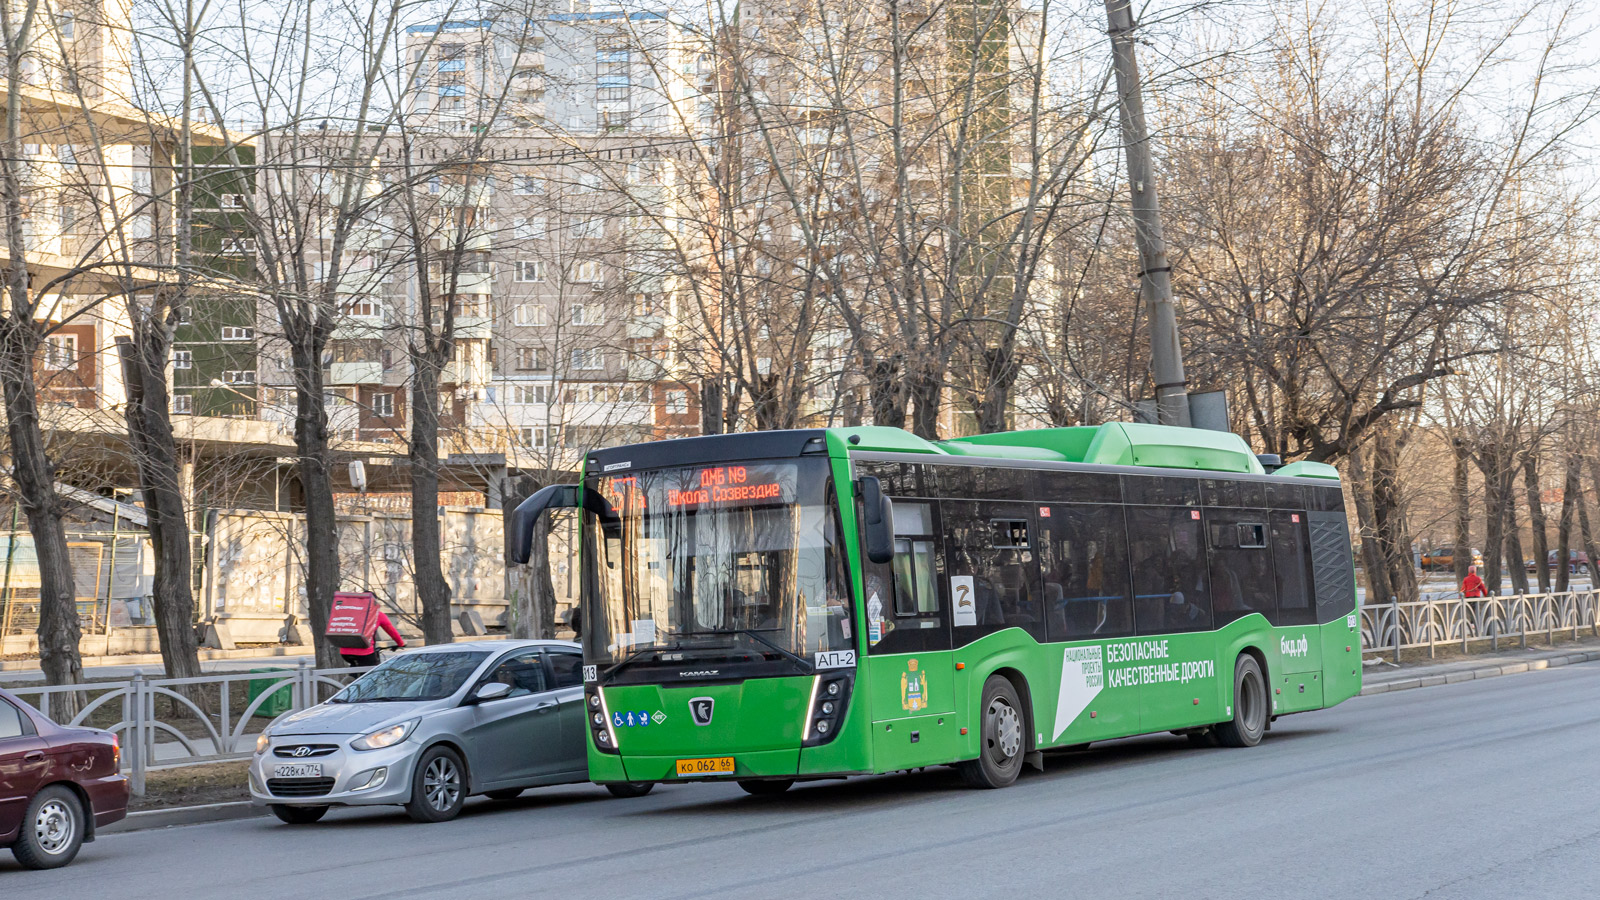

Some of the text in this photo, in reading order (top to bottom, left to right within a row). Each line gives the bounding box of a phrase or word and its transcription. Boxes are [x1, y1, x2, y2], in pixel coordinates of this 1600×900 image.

[701, 467, 725, 487] ДМБ
[668, 483, 780, 506] Школа Созвездие
[1107, 640, 1169, 663] БЕЗОПАСНЫЕ
[1280, 634, 1308, 657] бкд.рф
[818, 652, 854, 667] АП-2
[1066, 647, 1101, 662] НАЦИОНАЛЬНЫЕ
[679, 669, 719, 677] KAMAZ
[1082, 661, 1102, 674] ПРОЕКТЫ
[1108, 660, 1214, 688] КАЧЕСТВЕННЫЕ ДОРОГИ
[1086, 674, 1103, 688] РОССИИ
[697, 760, 715, 771] 062
[721, 759, 731, 767] 66
